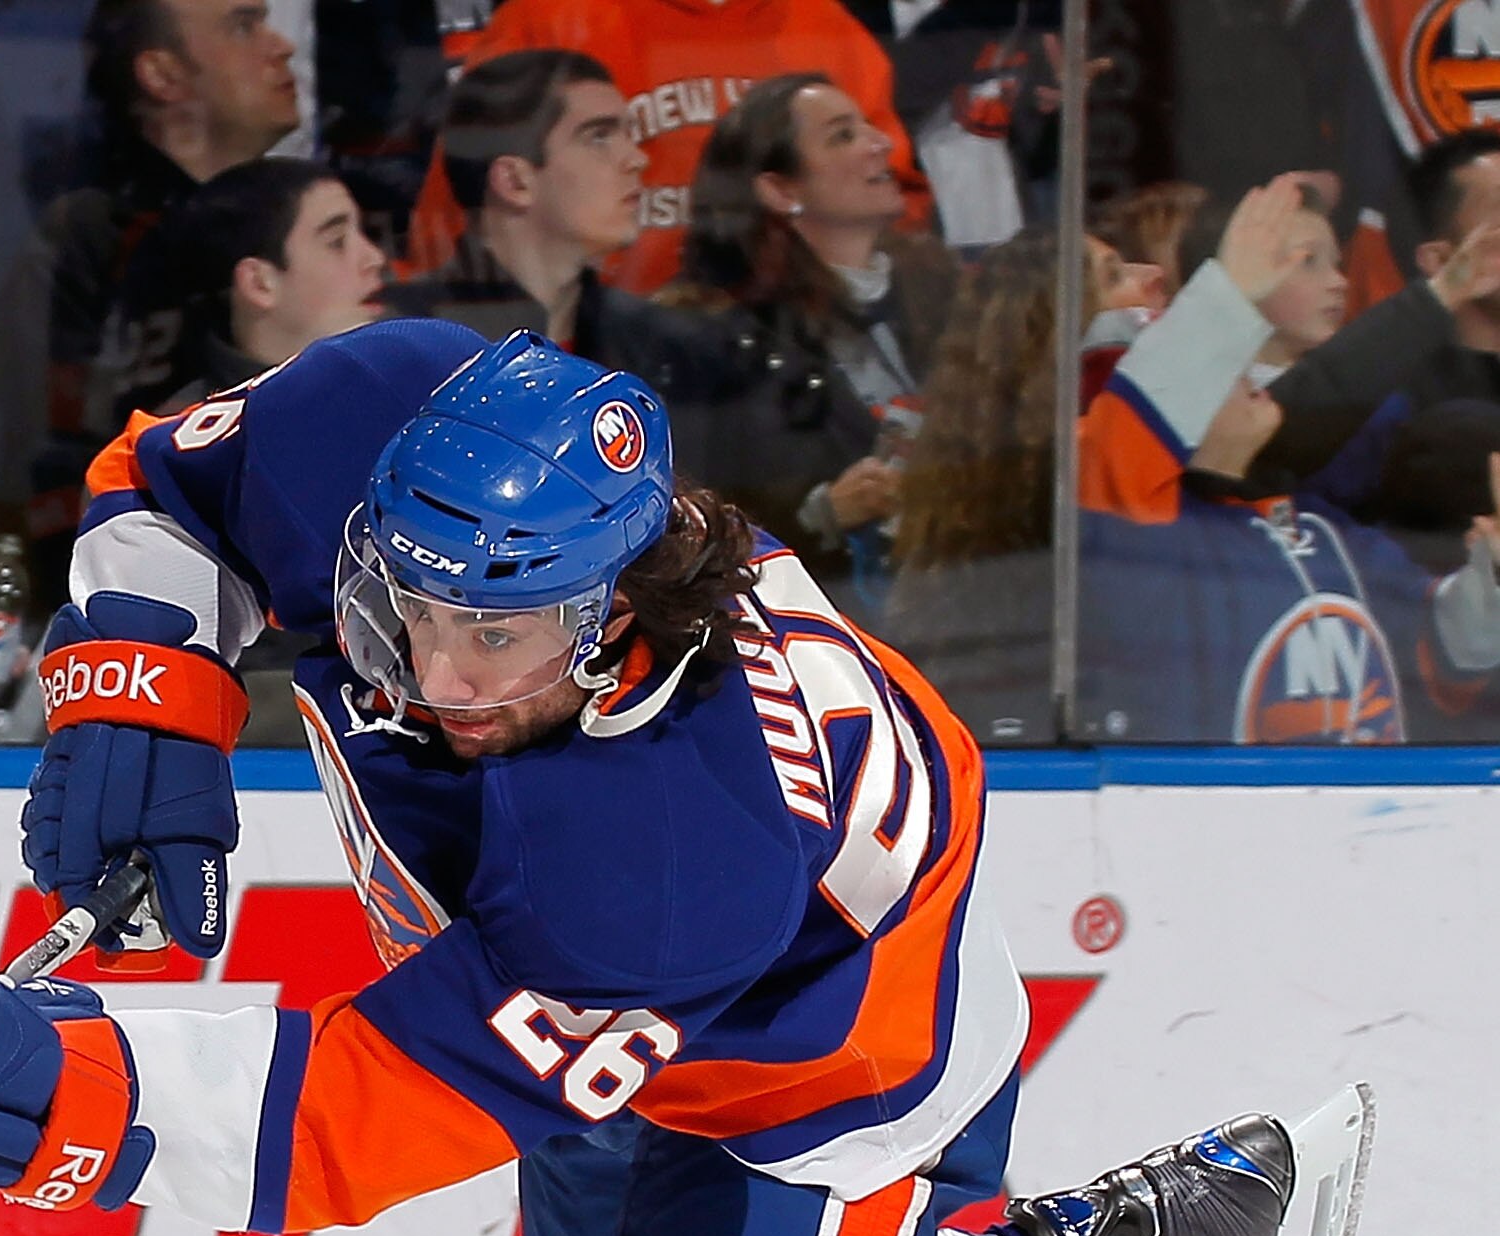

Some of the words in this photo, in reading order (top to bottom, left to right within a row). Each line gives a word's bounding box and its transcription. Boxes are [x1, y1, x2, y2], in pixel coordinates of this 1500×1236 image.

[390, 530, 468, 576] CCM
[200, 858, 217, 936] Reebok
[487, 988, 684, 1122] 26
